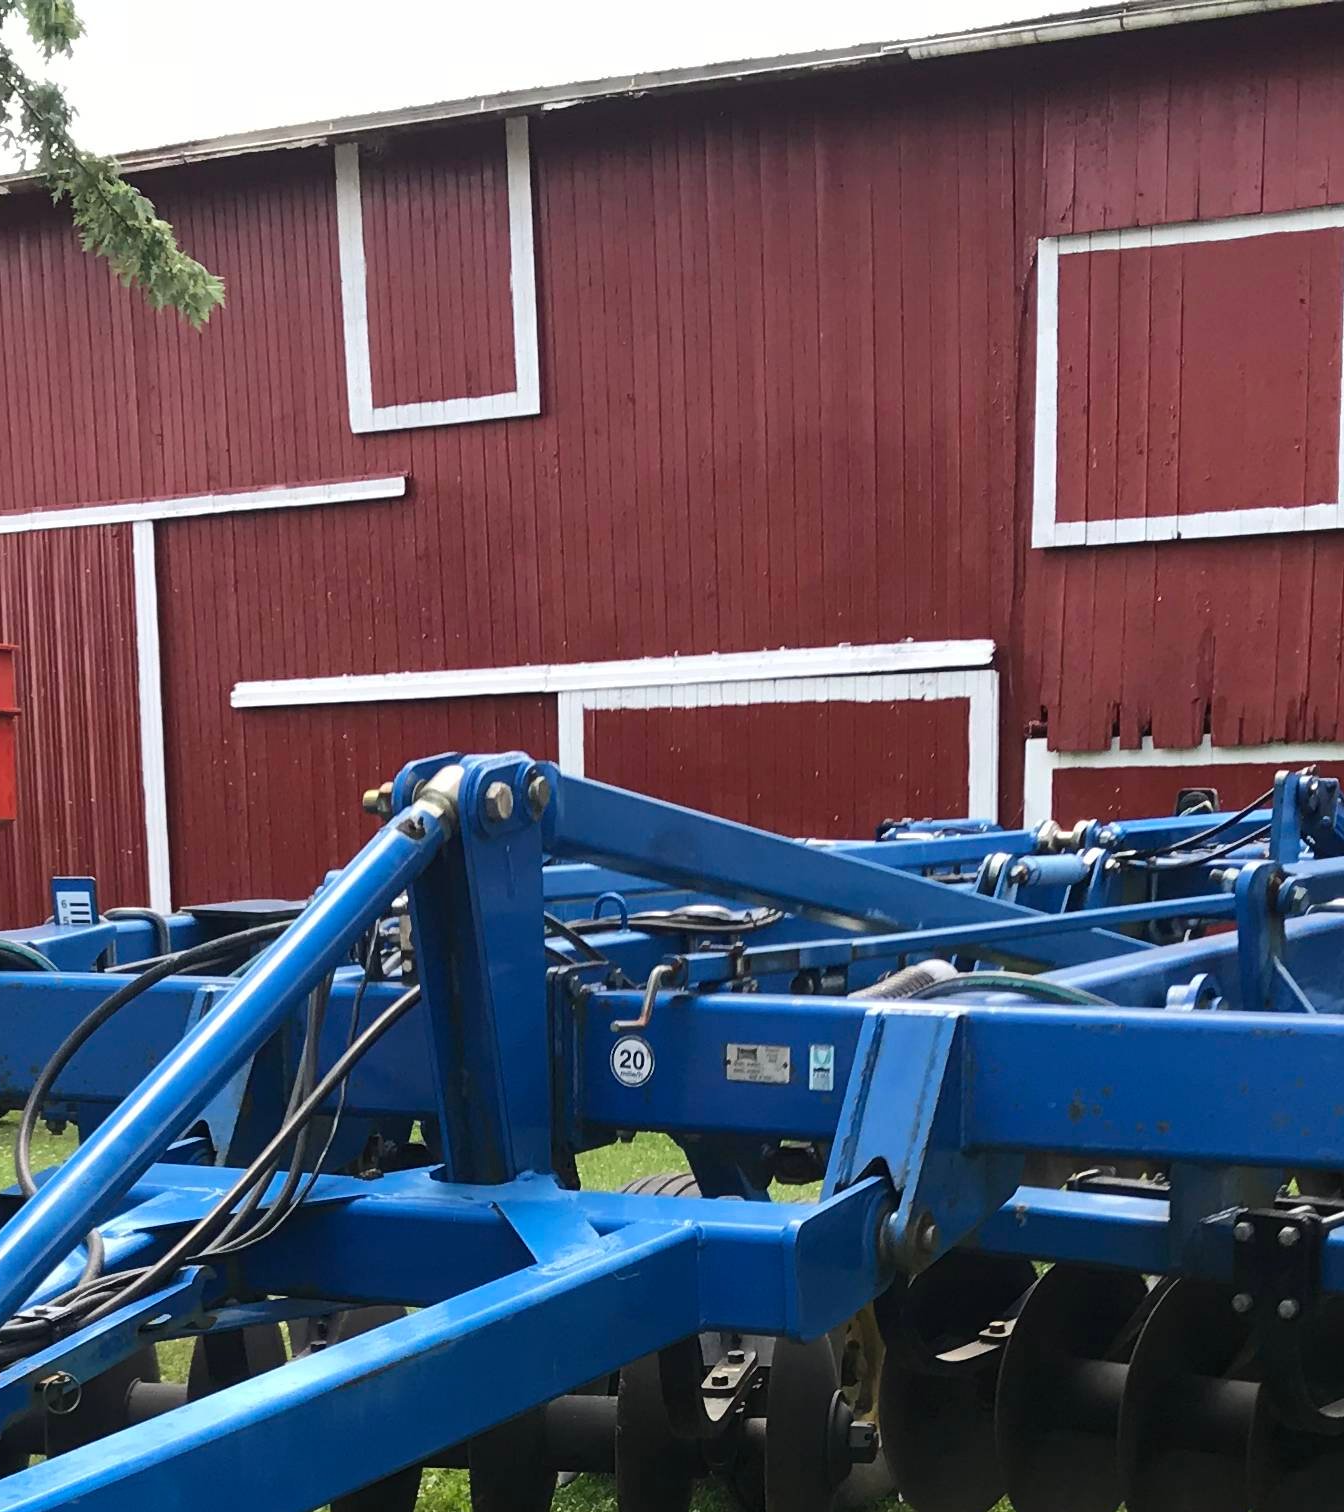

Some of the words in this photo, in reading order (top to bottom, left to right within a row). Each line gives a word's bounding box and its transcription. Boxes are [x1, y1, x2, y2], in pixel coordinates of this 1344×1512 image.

[60, 899, 68, 909] 6
[62, 916, 70, 925] 5
[619, 1049, 645, 1071] 20
